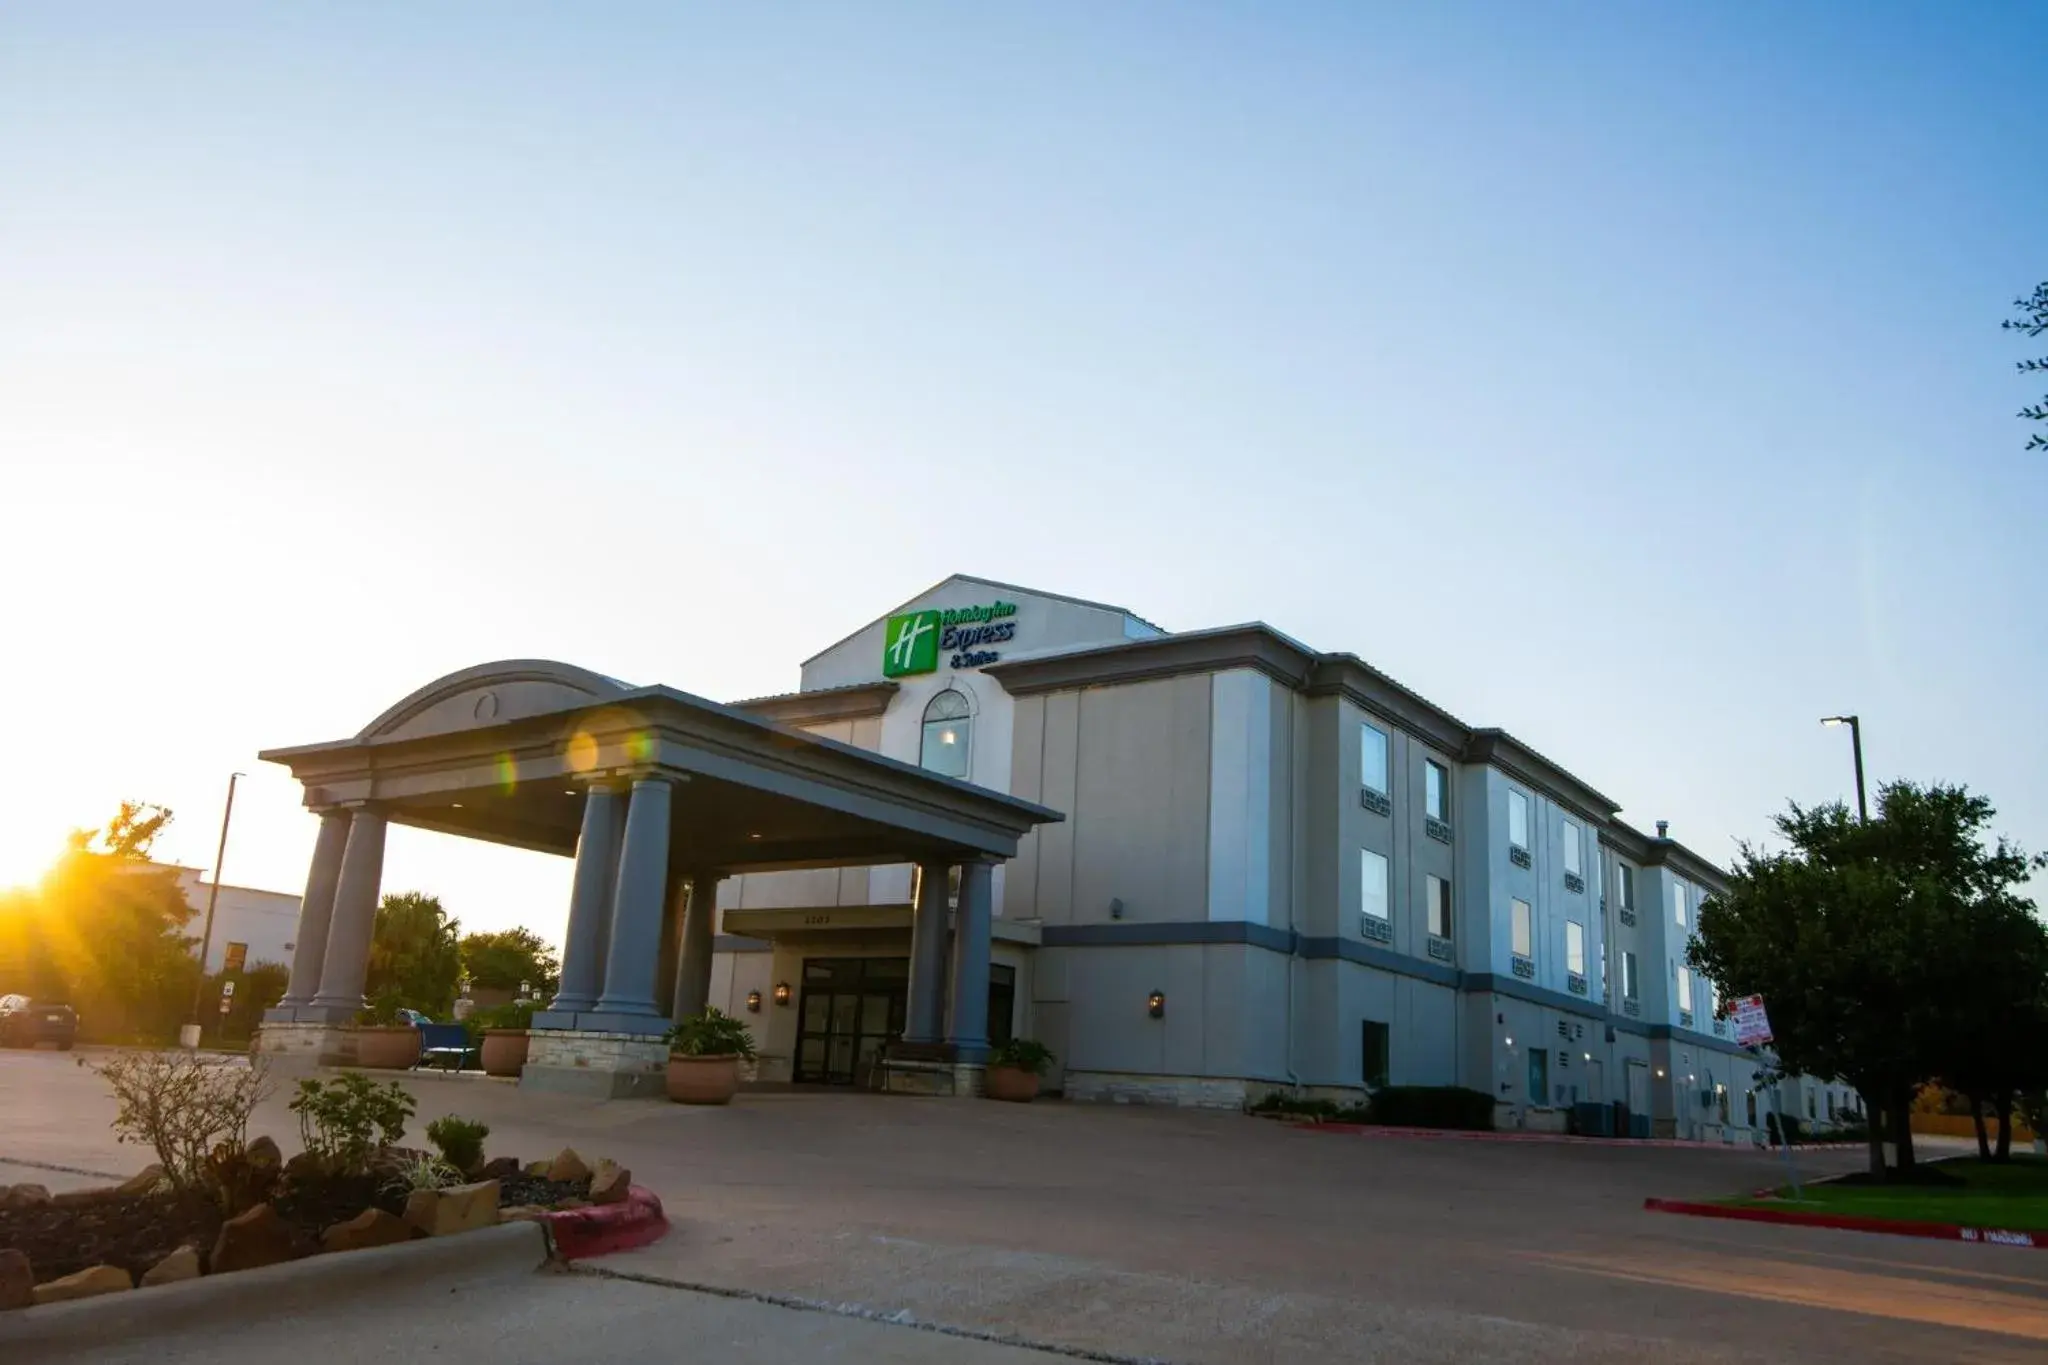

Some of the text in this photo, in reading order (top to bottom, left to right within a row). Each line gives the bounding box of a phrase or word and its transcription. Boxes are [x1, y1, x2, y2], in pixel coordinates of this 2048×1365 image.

[941, 606, 994, 625] Holiday
[941, 622, 1016, 652] Express
[962, 651, 998, 667] Suites
